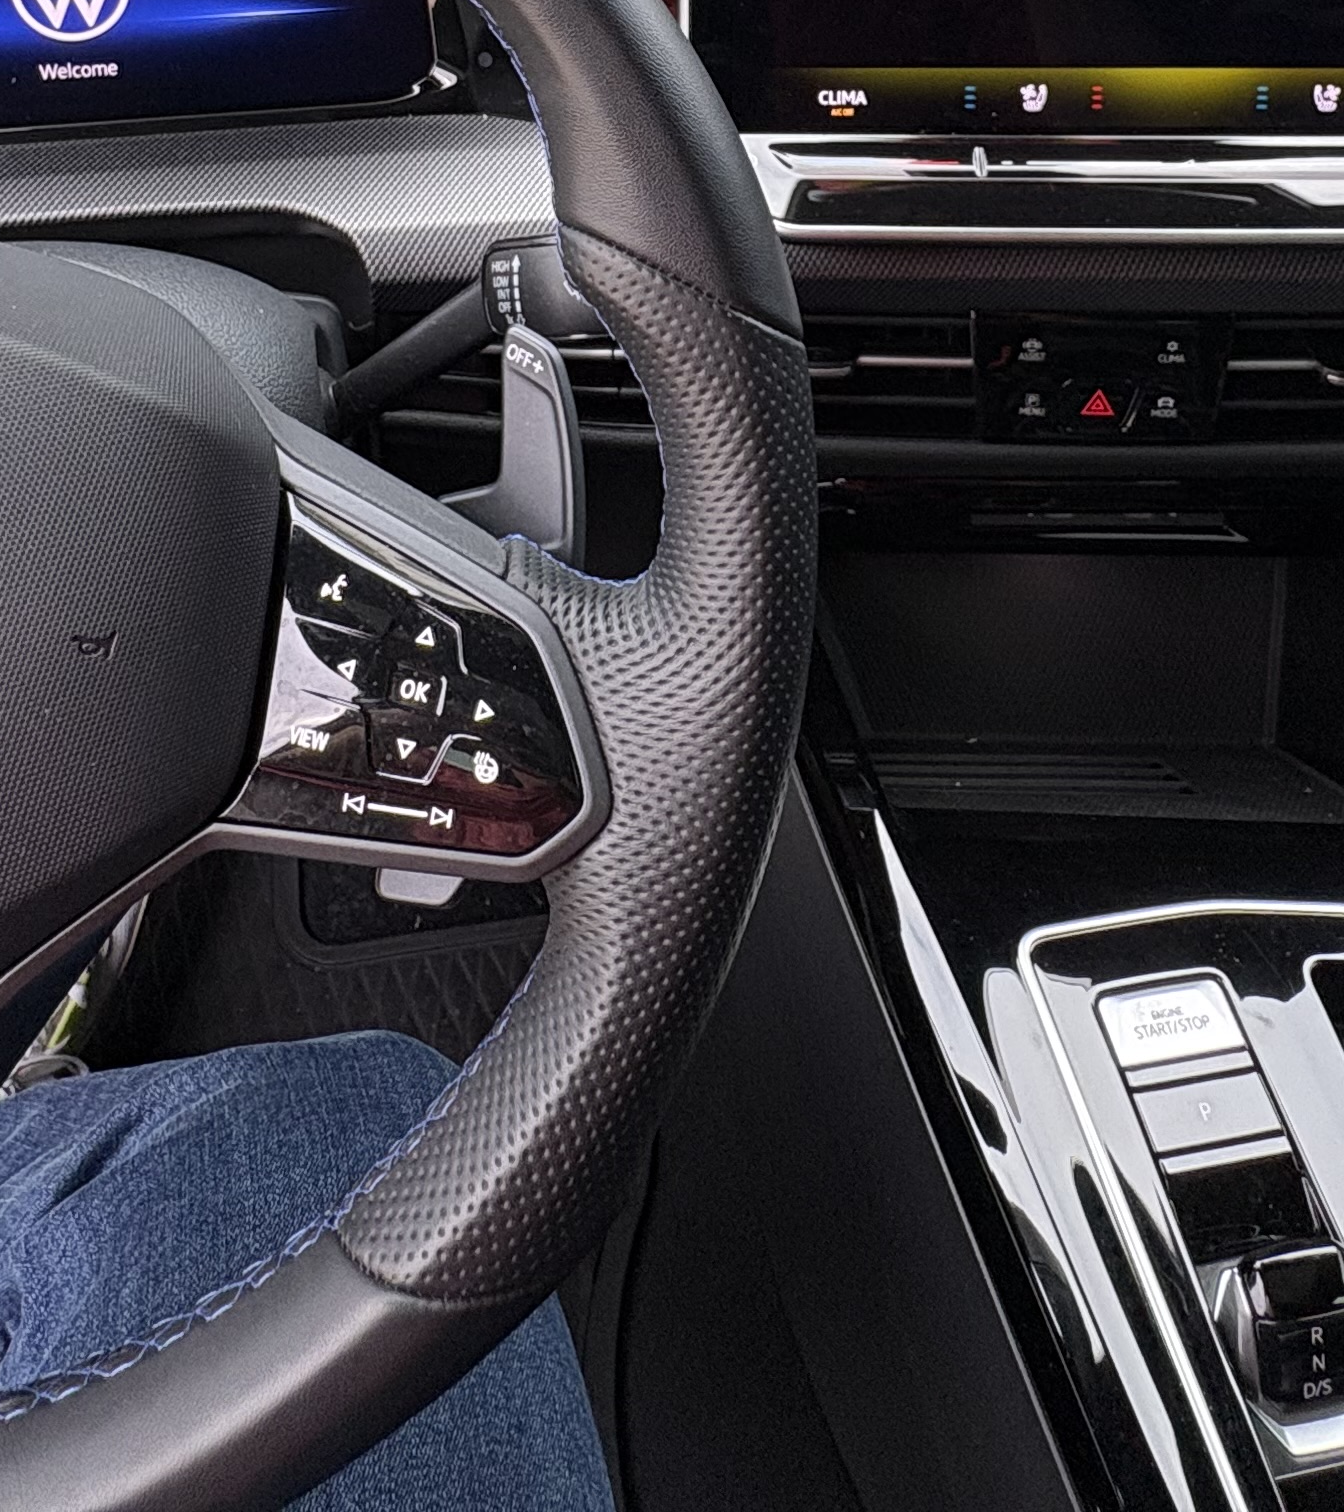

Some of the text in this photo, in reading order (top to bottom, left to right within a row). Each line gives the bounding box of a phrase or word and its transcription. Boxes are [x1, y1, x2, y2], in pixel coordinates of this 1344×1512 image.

[38, 61, 119, 81] Welcome
[817, 89, 869, 106] CLIMA
[490, 259, 511, 274] HIGH
[492, 275, 510, 288] LOW
[498, 301, 512, 314] OFF
[399, 679, 431, 704] OK
[289, 725, 330, 753] VIEW
[1133, 1014, 1210, 1041] START/STOP
[1197, 1101, 1213, 1122] P
[1310, 1326, 1325, 1346] R
[1312, 1353, 1327, 1373] N
[1303, 1377, 1334, 1400] D/S
